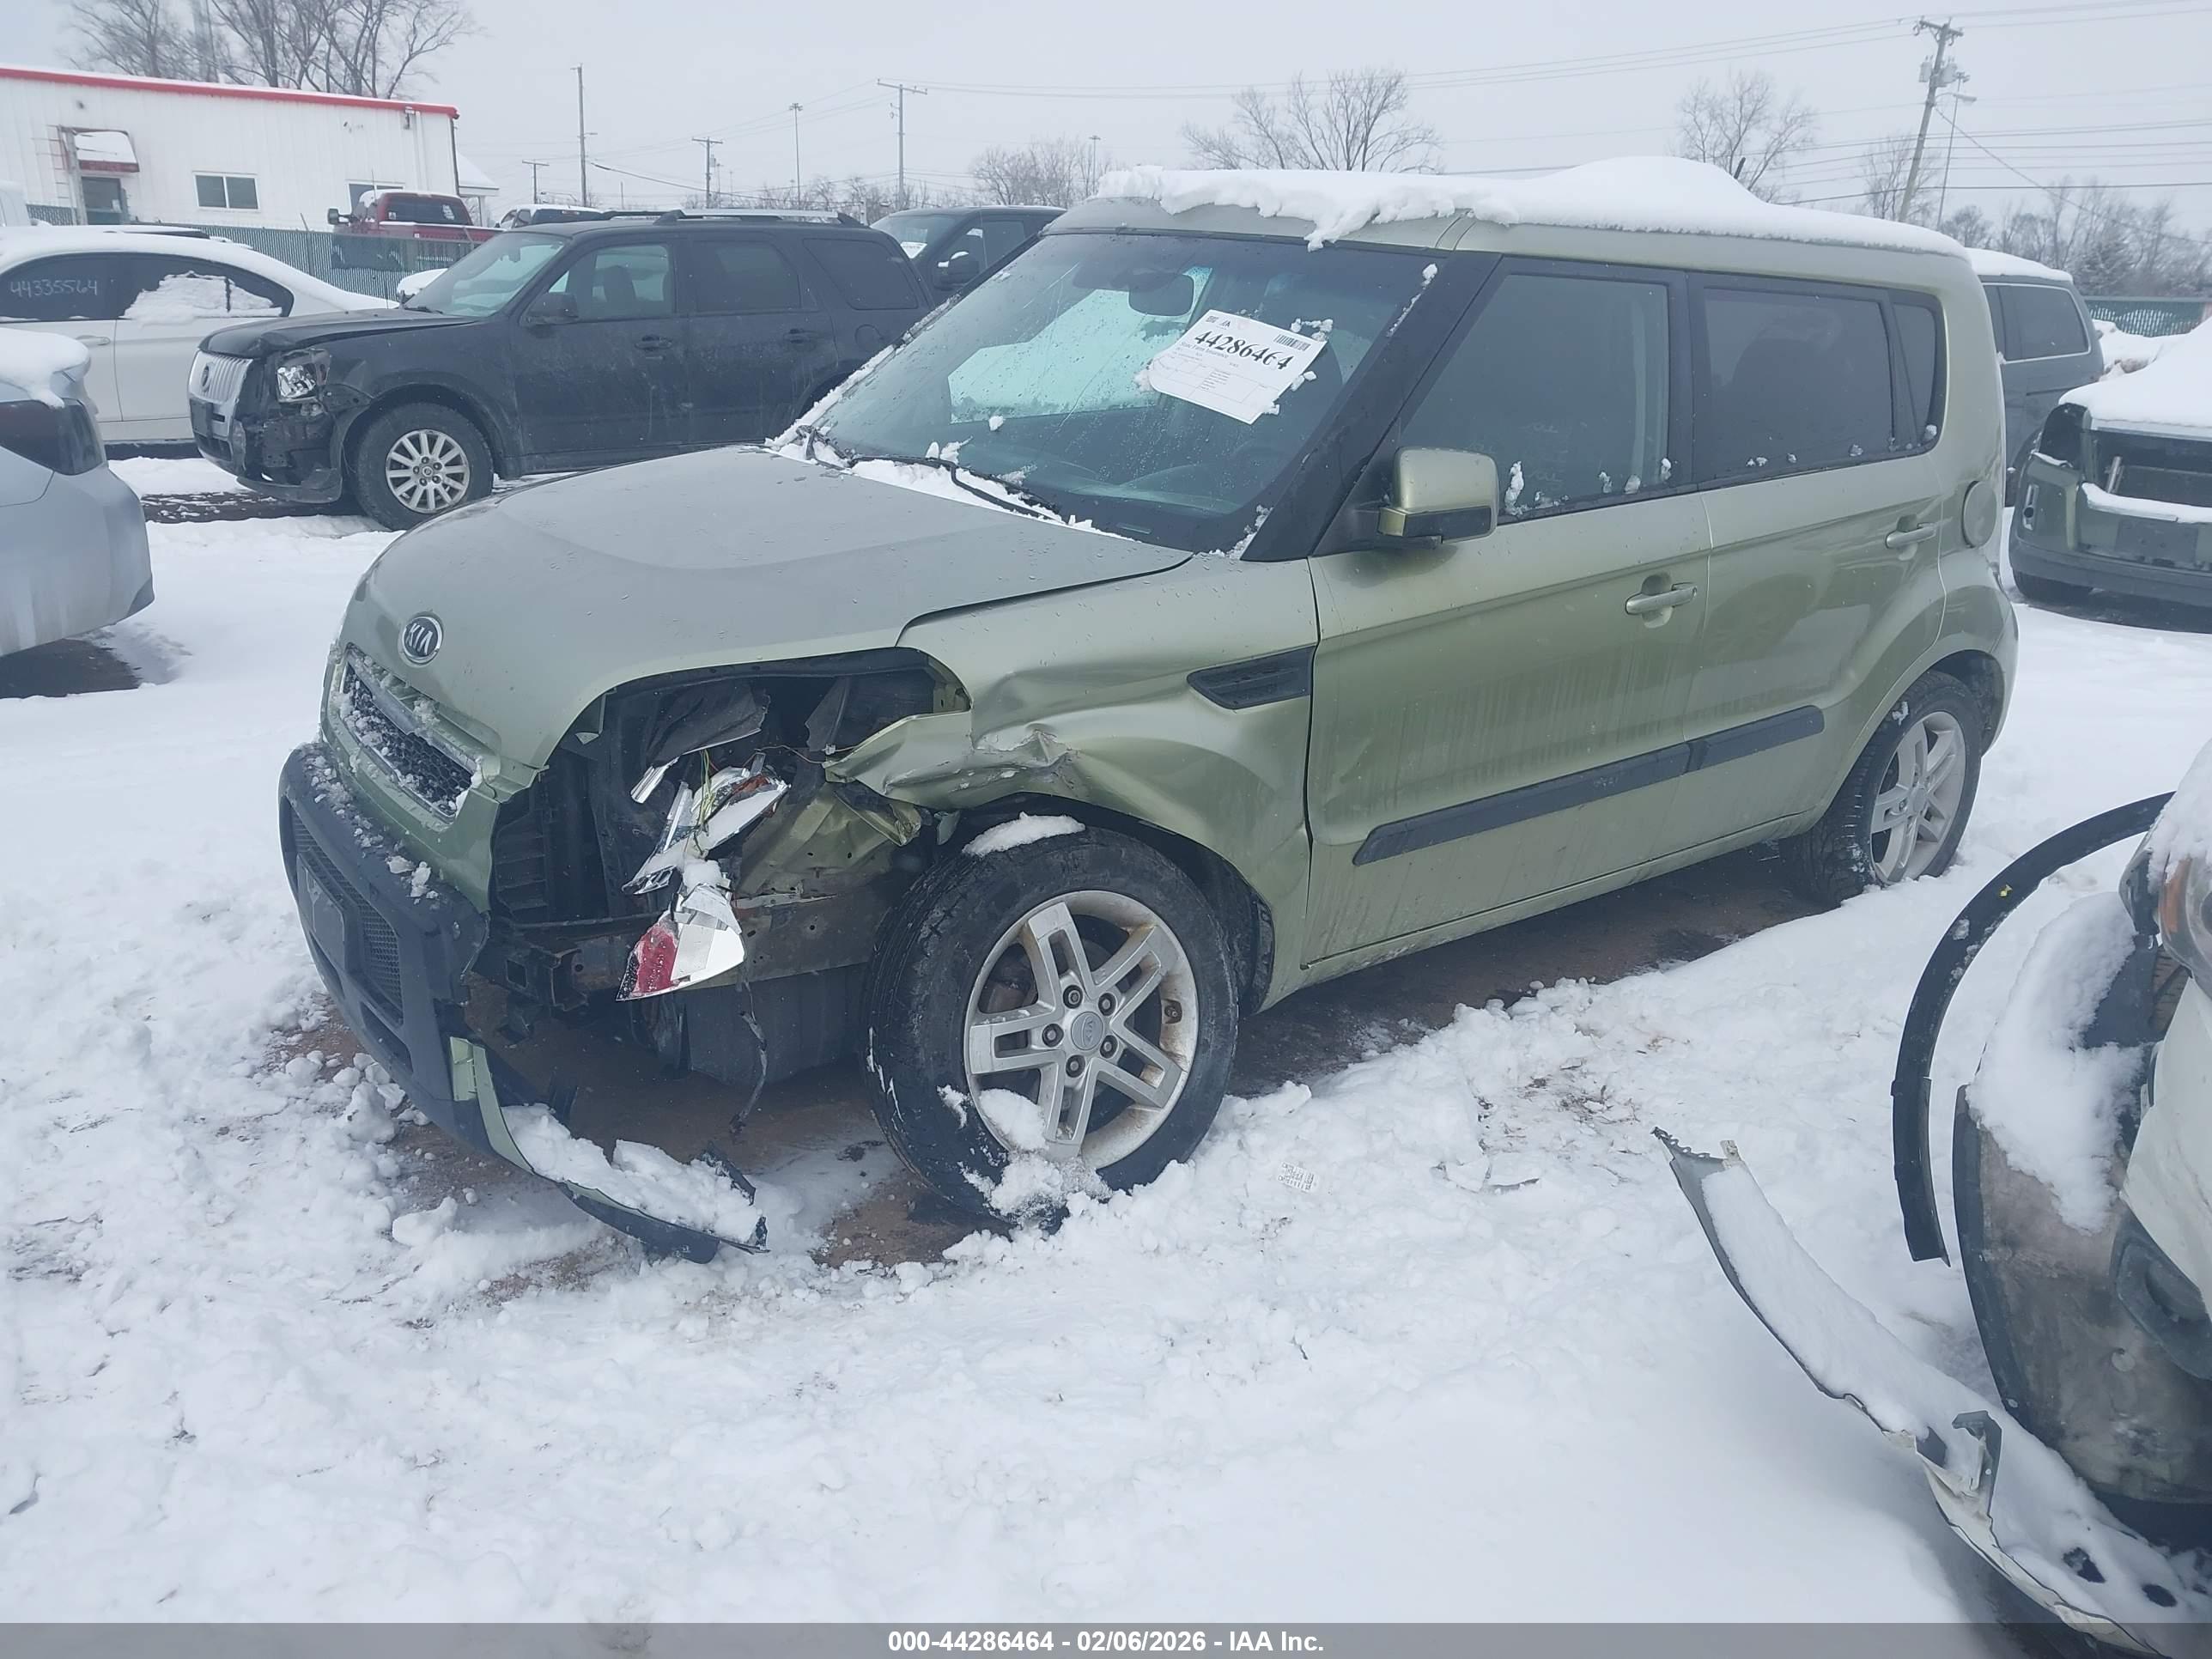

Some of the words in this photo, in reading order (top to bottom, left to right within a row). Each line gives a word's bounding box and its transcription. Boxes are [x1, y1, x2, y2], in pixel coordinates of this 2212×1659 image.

[9, 279, 98, 298] 44335564
[1194, 331, 1295, 370] 44286464
[405, 623, 433, 655] KIA
